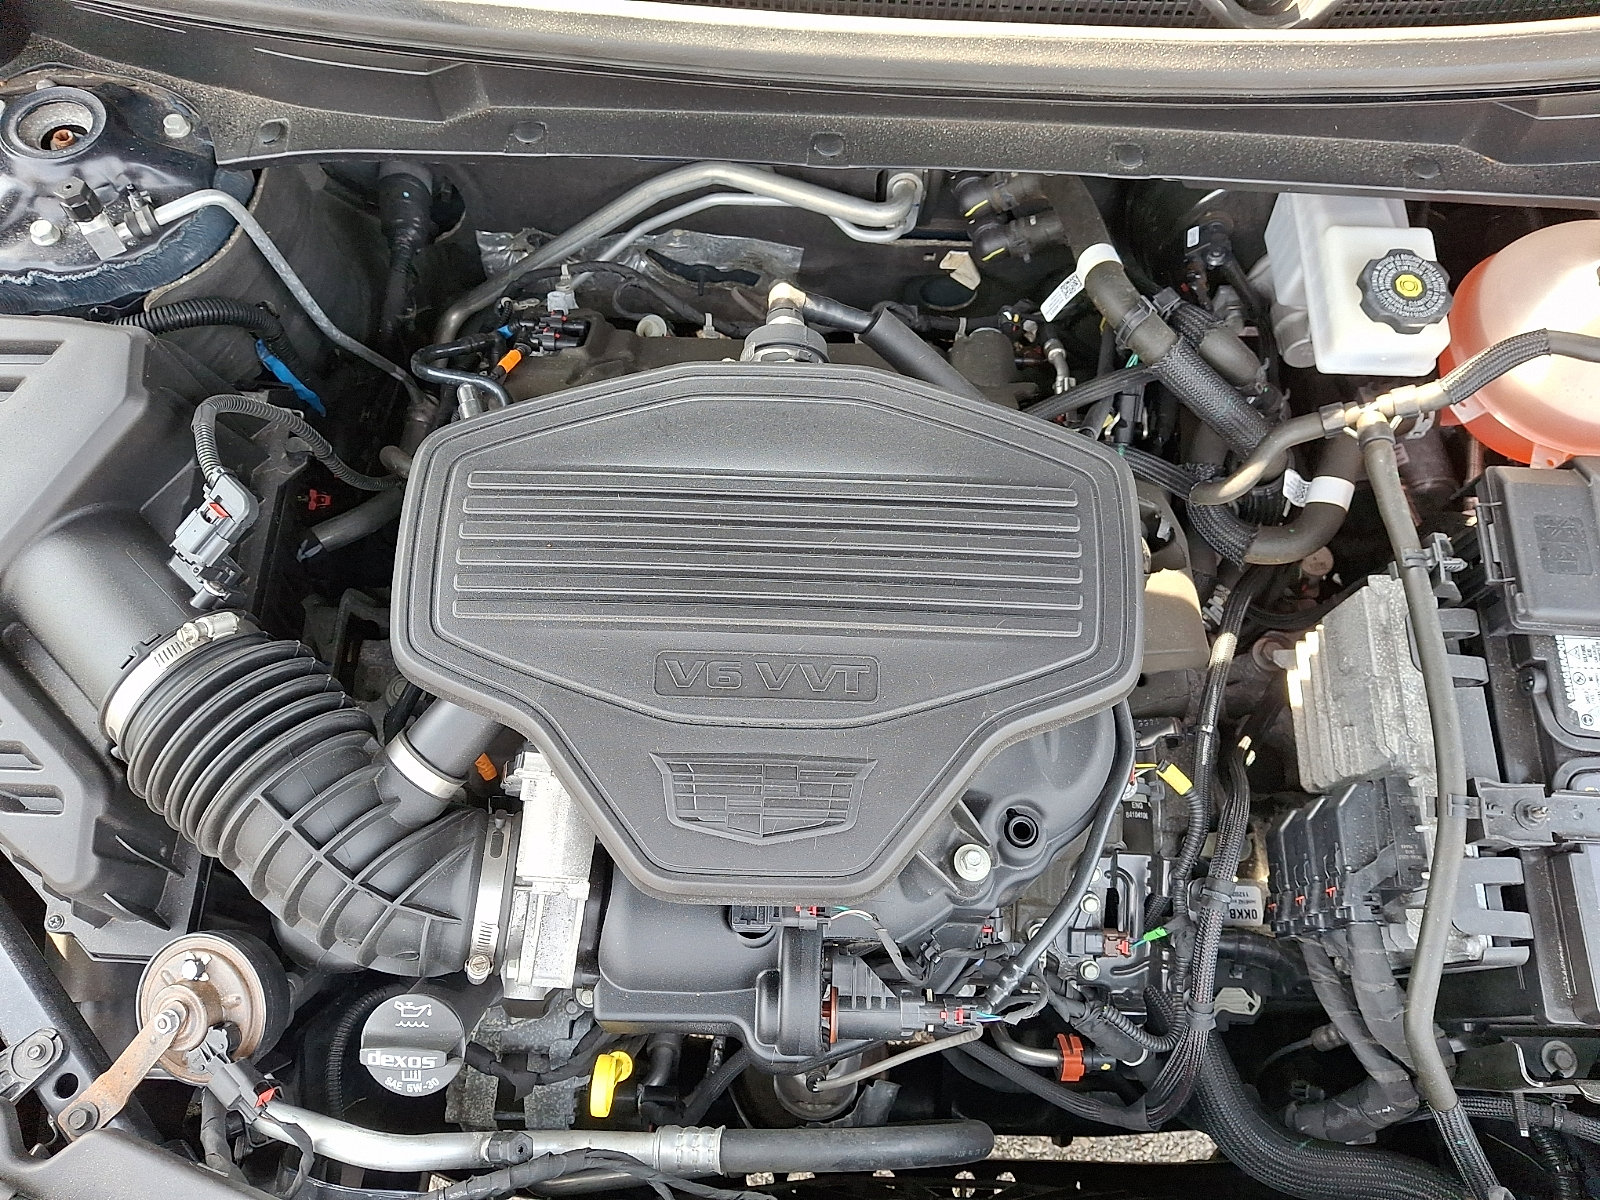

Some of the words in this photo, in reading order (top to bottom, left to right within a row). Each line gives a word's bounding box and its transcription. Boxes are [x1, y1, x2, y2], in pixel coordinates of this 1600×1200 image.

[664, 659, 743, 690] V6
[755, 661, 871, 693] VVT
[367, 1049, 438, 1069] dexos
[384, 1076, 403, 1091] SAE
[406, 1077, 440, 1093] 5W-30
